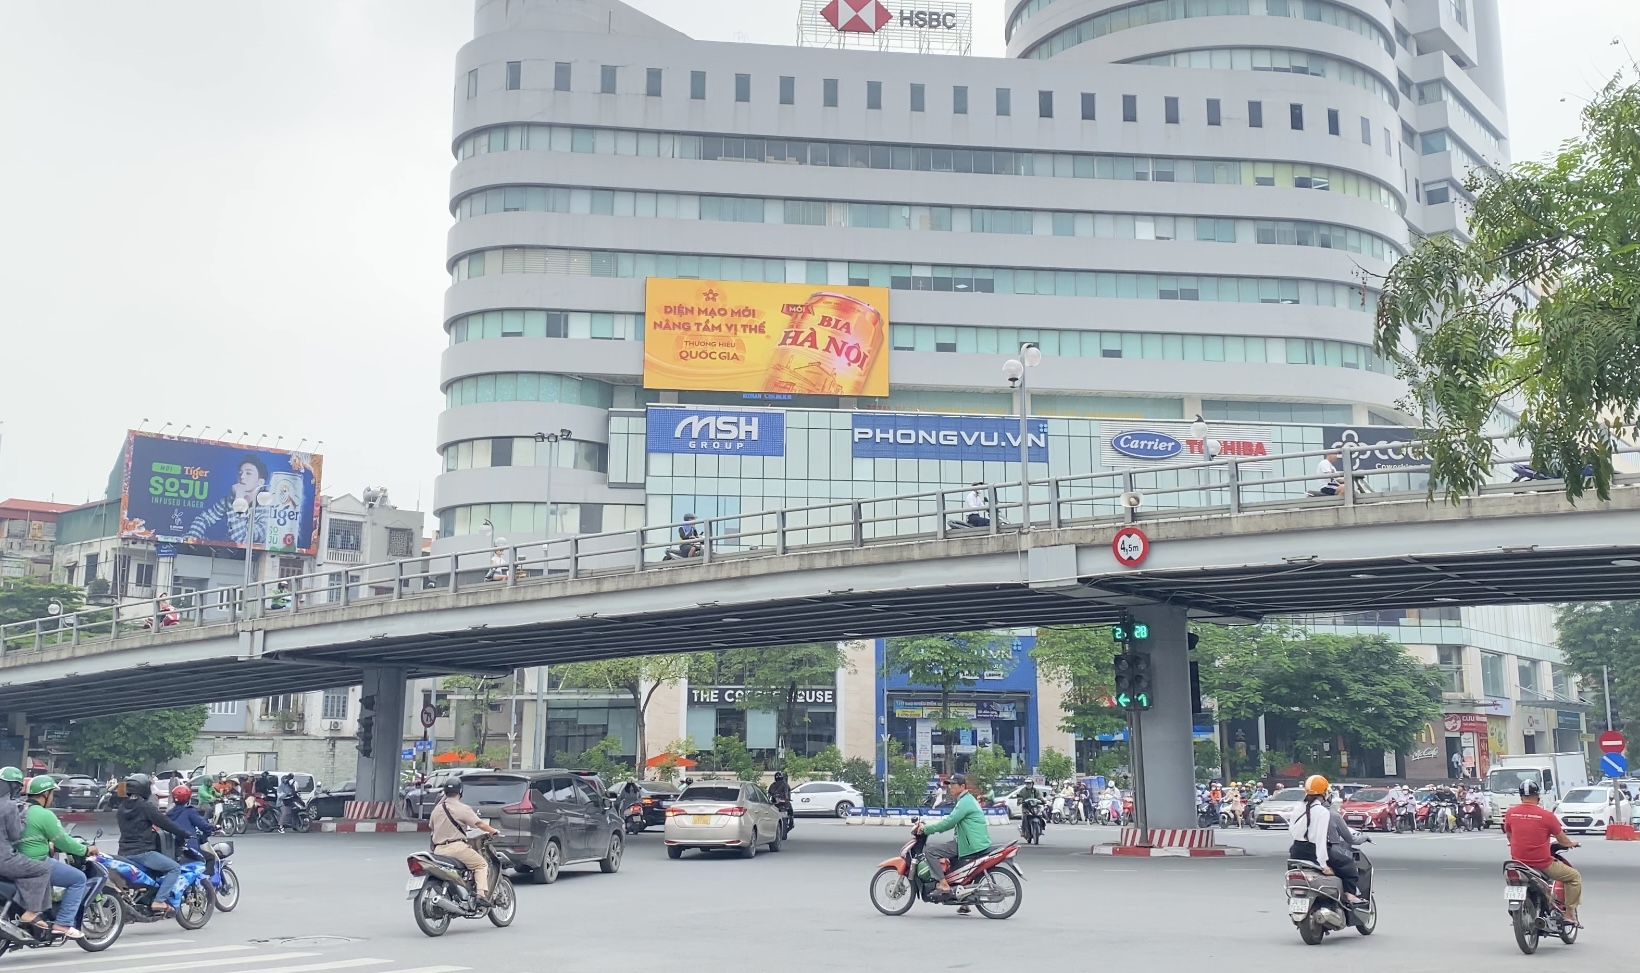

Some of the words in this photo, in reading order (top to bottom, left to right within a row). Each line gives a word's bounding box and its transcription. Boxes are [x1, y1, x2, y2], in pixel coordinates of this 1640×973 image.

[900, 10, 956, 29] HSBC
[664, 304, 694, 317] DIỆN
[698, 307, 727, 318] MẠO
[731, 306, 756, 318] MỚI
[653, 319, 691, 331] NÂNG
[725, 323, 738, 335] VỊ
[818, 315, 851, 335] BIA
[679, 350, 717, 361] QUỐC
[718, 352, 740, 361] GIA
[778, 327, 819, 350] HÀ
[822, 336, 869, 371] NỘI
[674, 415, 759, 440] MSH
[688, 441, 744, 450] GROUP
[854, 428, 1046, 448] PHONGVU.VN
[1119, 435, 1175, 452] Carrier
[183, 465, 210, 480] Tiger
[151, 496, 181, 506] INFUSED
[183, 499, 204, 509] LAGER
[692, 690, 719, 702] THE
